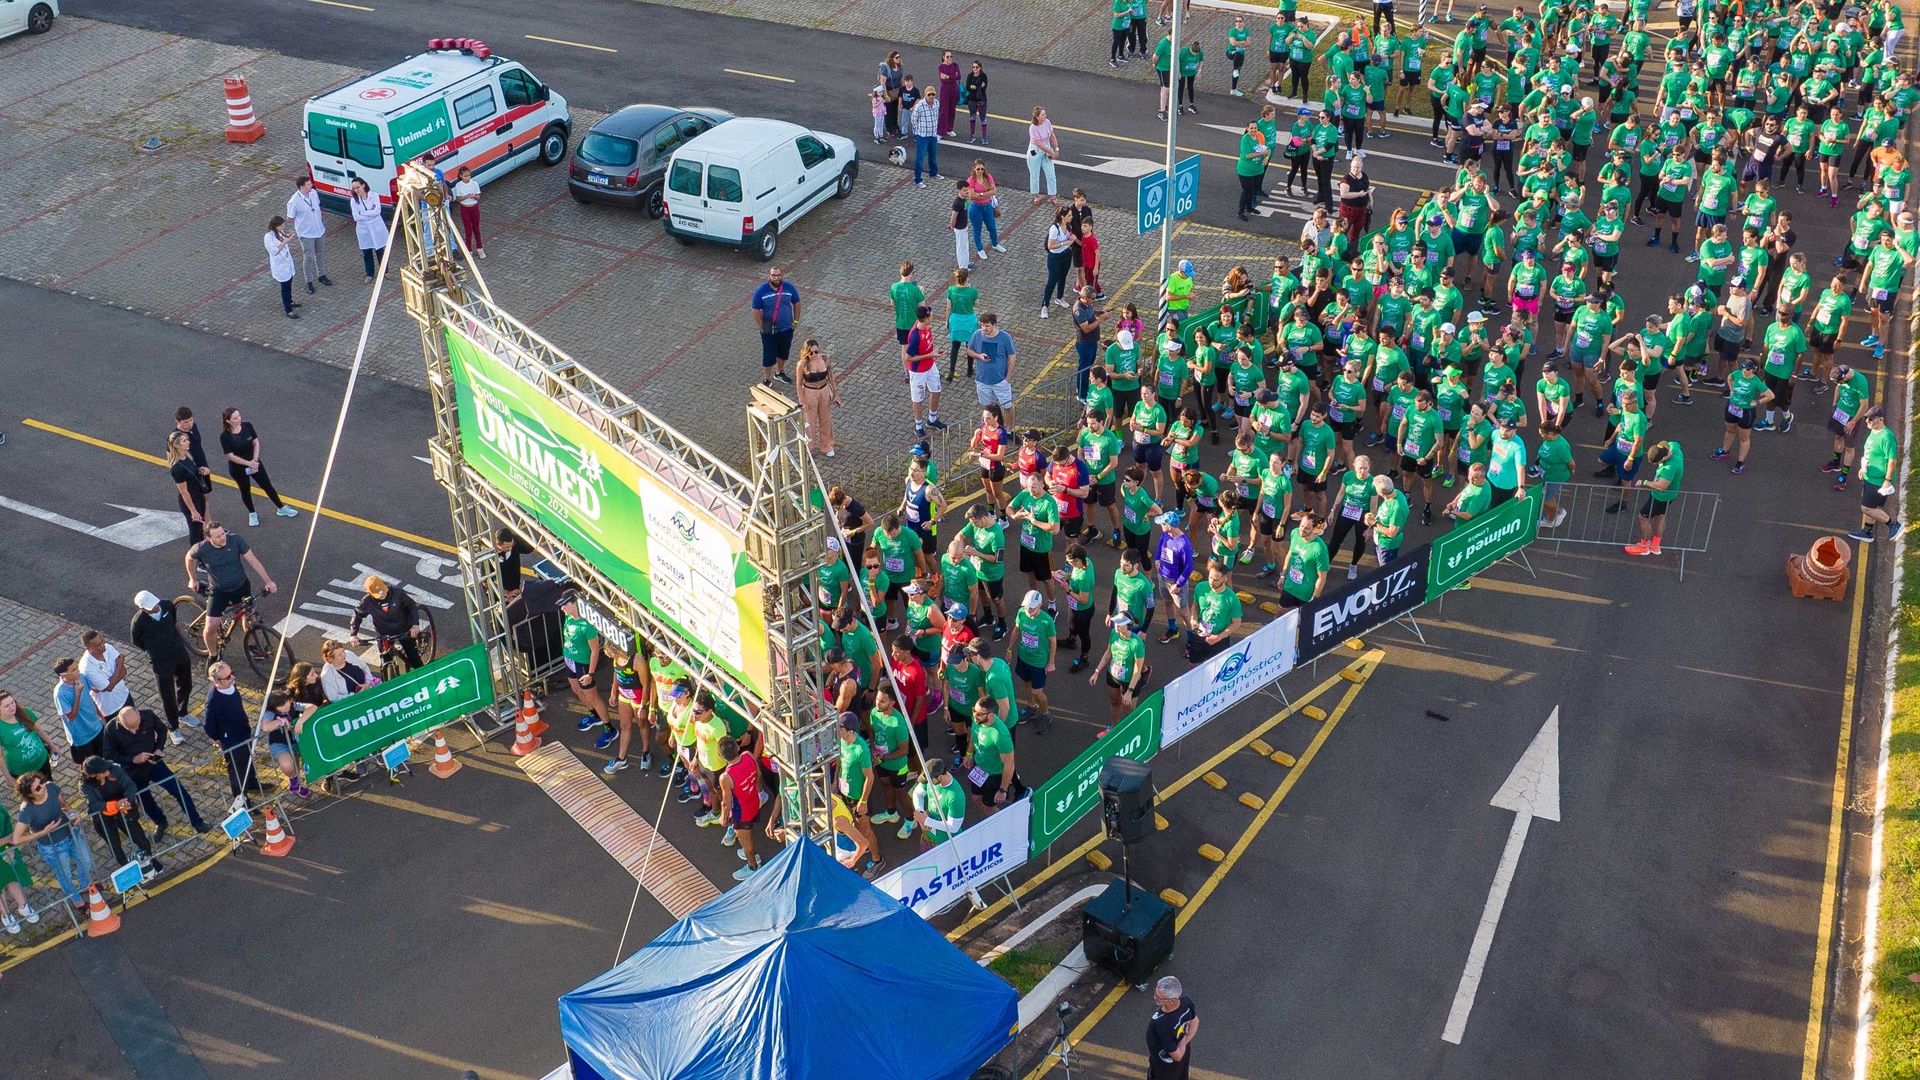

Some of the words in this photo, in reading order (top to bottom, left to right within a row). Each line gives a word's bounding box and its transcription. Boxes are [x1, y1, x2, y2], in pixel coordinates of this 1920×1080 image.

[397, 122, 433, 147] Unimed
[1182, 177, 1189, 191] A
[1150, 190, 1158, 205] A
[1177, 194, 1192, 214] 06
[1144, 208, 1161, 228] 06
[473, 395, 600, 521] UNIMED
[509, 465, 540, 497] Limeira
[547, 496, 569, 519] 2023
[1465, 518, 1521, 560] Unimed
[1467, 527, 1490, 543] Limeira
[1312, 617, 1358, 645] LUXURY
[1368, 590, 1410, 616] SPORTS
[1176, 698, 1225, 731] IMAGENS
[1232, 663, 1282, 697] DIGITAIS
[1177, 651, 1283, 721] MedDiagnóstico
[332, 686, 430, 737] Unimed
[396, 703, 433, 723] Limeira
[1078, 756, 1103, 780] Limeira
